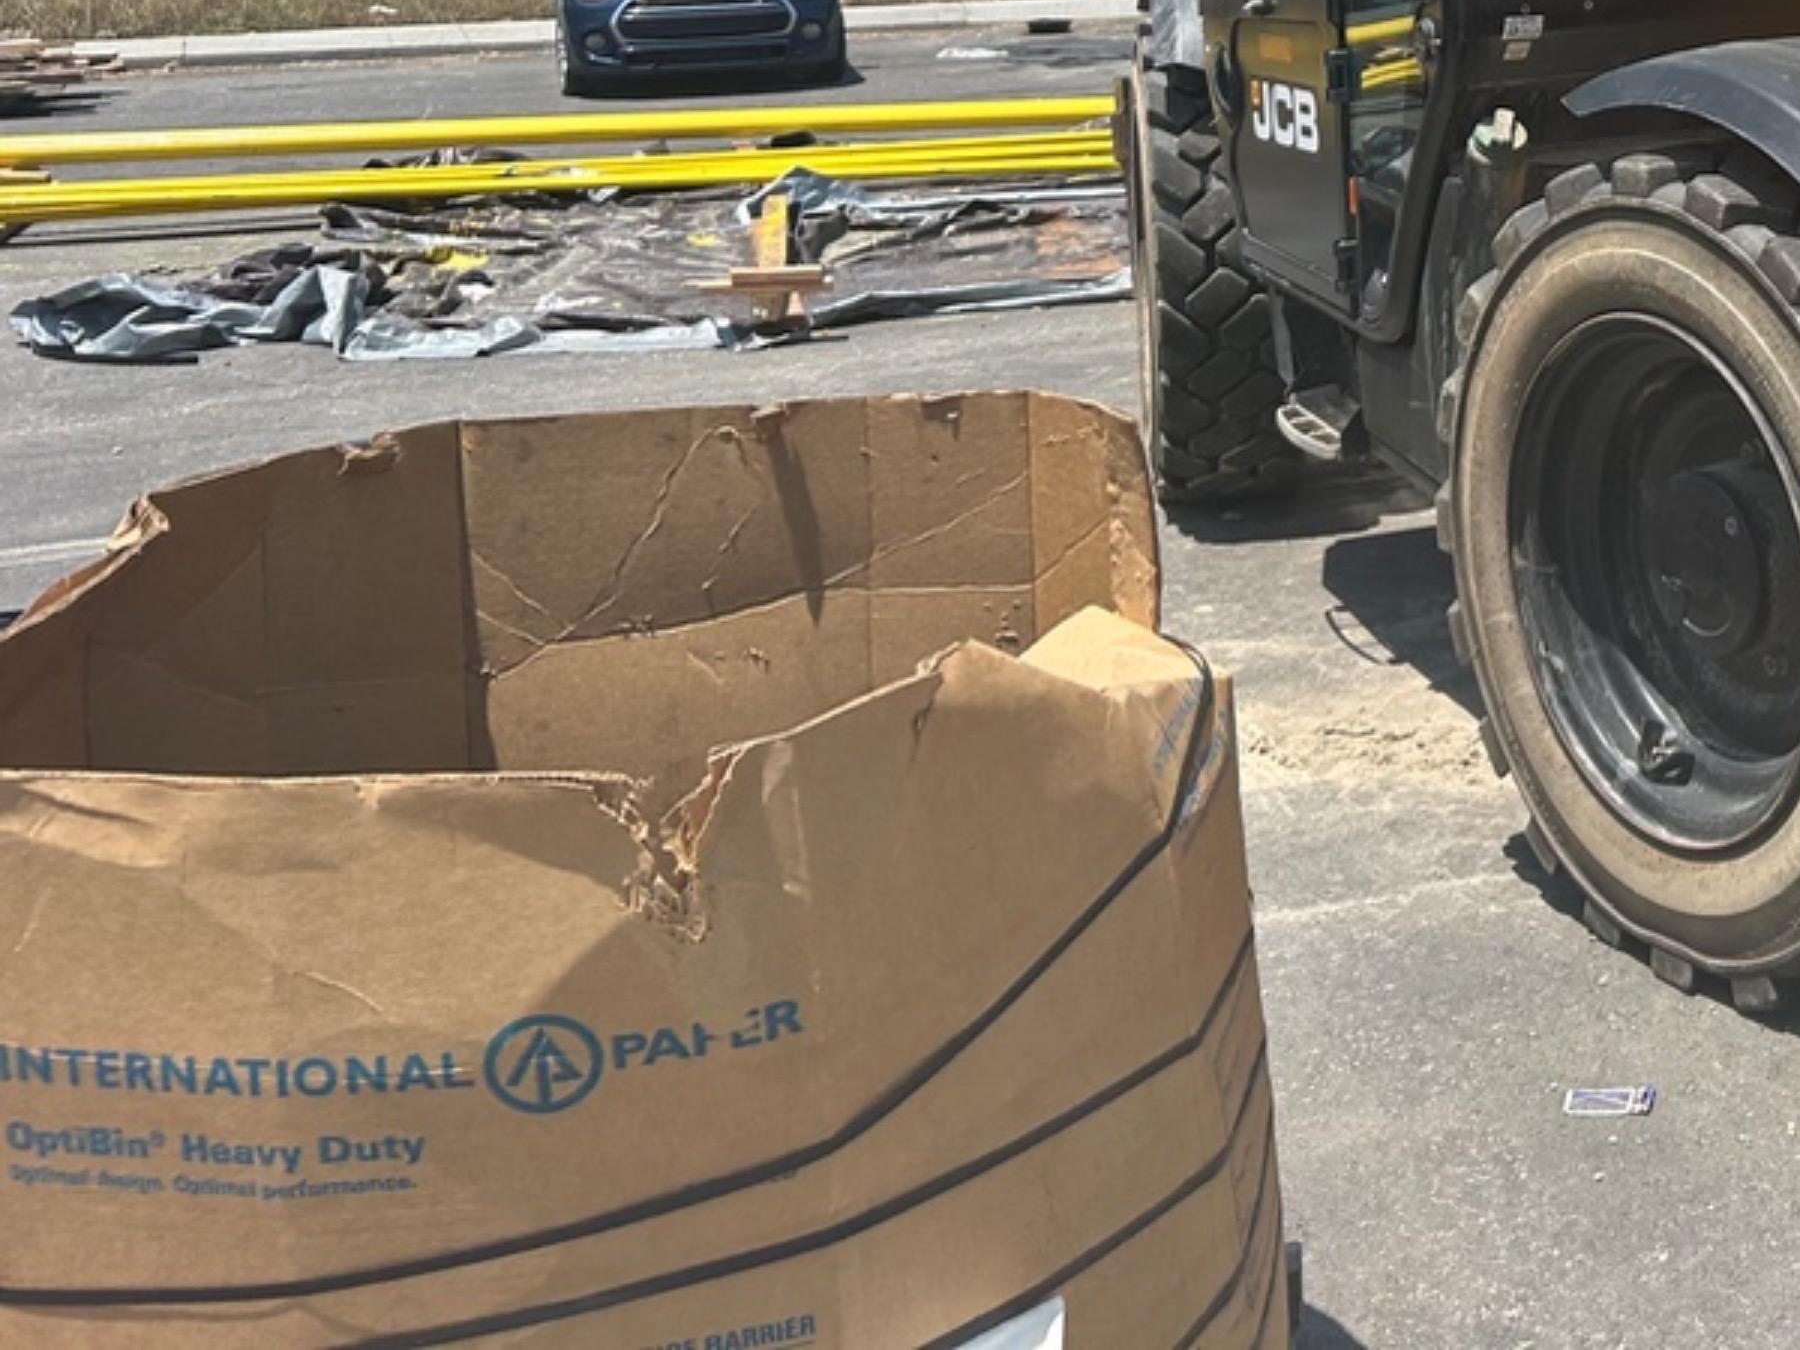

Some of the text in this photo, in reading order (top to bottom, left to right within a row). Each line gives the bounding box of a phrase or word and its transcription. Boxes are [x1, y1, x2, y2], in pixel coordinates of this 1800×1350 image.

[1253, 80, 1320, 154] JCB
[0, 1044, 474, 1098] INTERNATIONAL
[181, 1133, 303, 1174] Heavy
[319, 1134, 427, 1165] Duty
[262, 1175, 417, 1201] performance.
[704, 1313, 817, 1350] BARRIER
